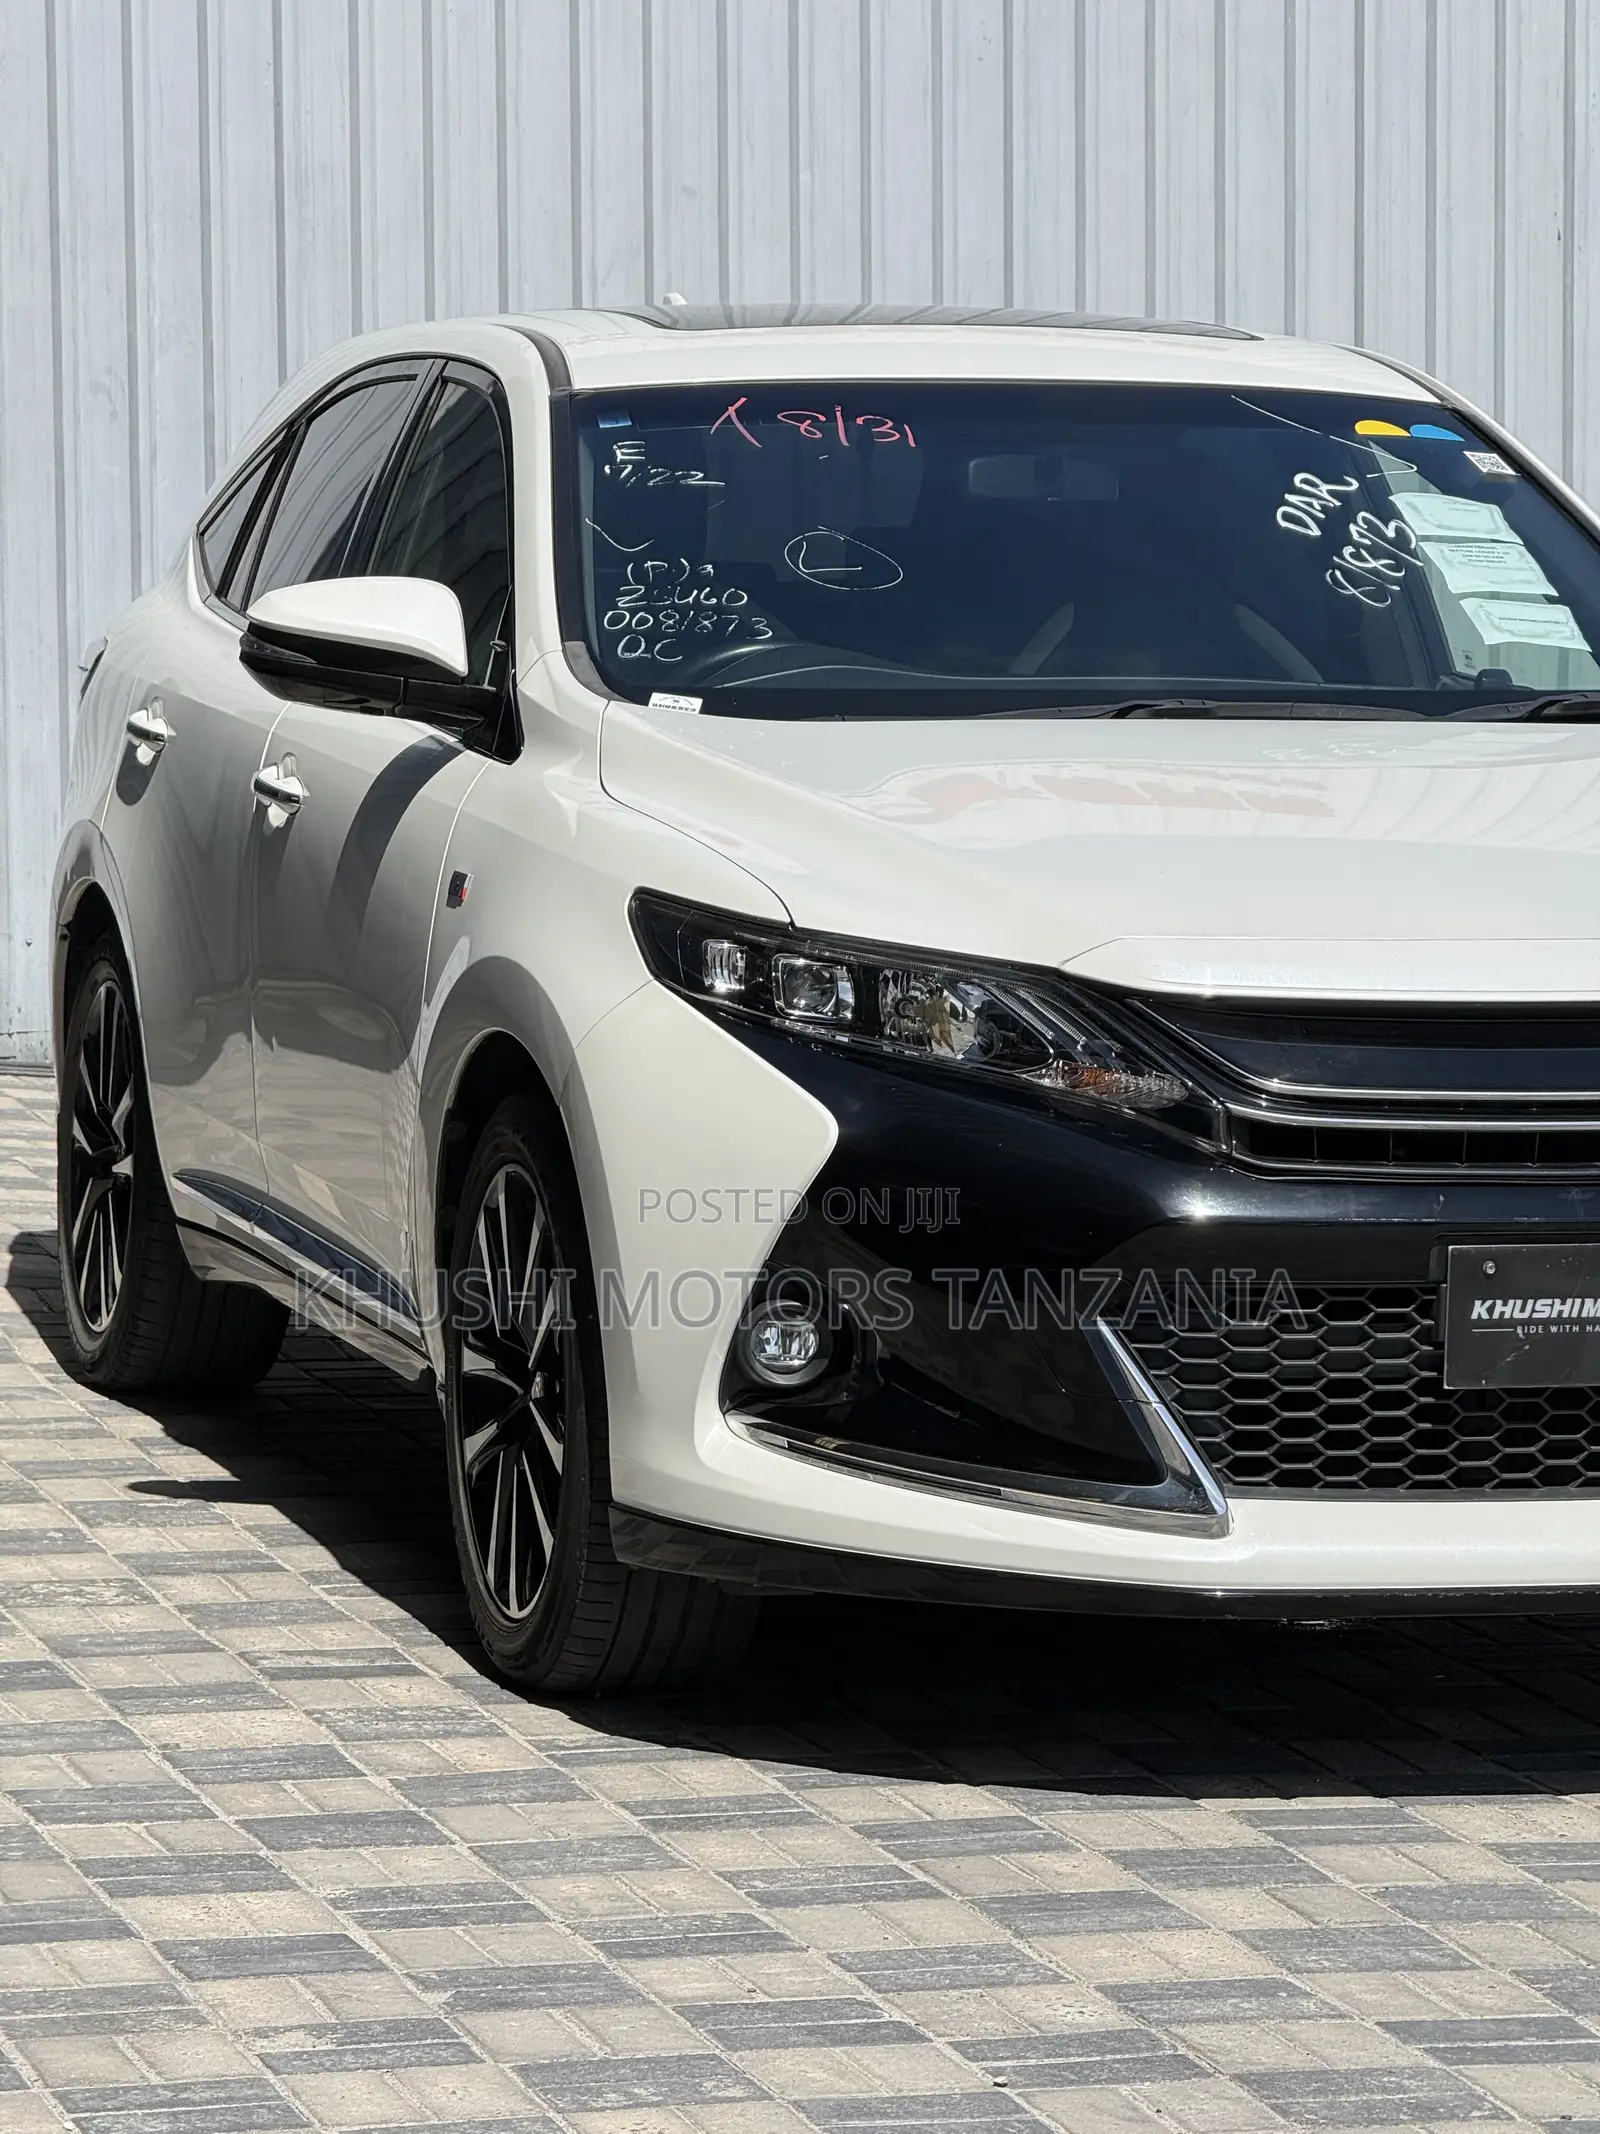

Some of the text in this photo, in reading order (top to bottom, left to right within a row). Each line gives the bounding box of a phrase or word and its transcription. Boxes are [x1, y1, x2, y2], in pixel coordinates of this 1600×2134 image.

[1276, 472, 1360, 536] DAR
[1516, 1324, 1545, 1335] RIDE
[1549, 1323, 1580, 1334] WITH
